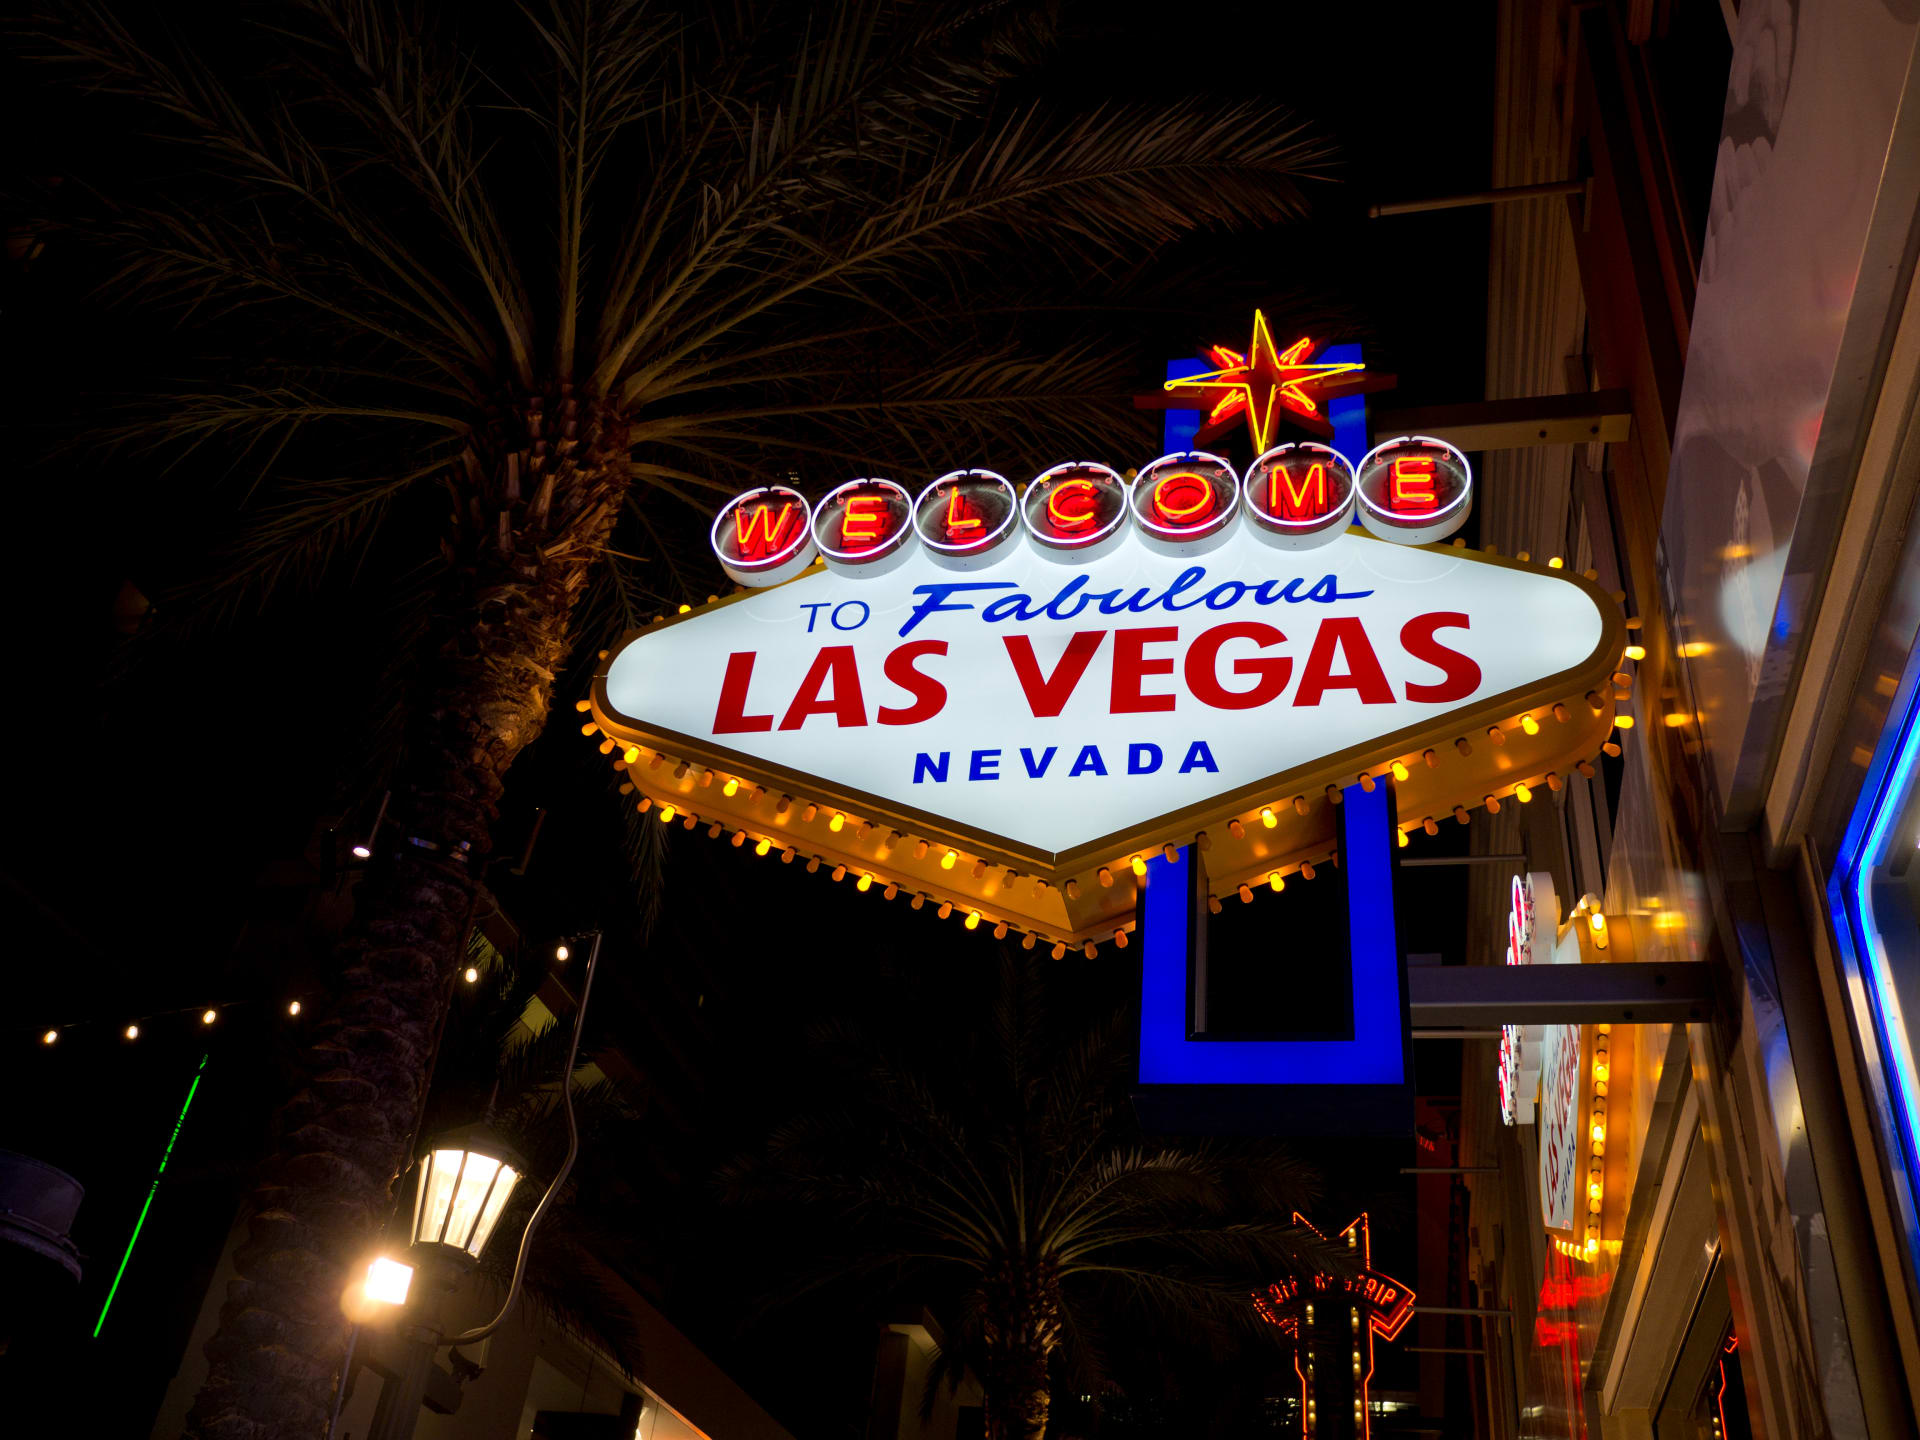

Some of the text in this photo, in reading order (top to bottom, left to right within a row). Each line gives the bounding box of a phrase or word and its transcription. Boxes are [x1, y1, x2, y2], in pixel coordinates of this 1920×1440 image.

[735, 456, 1437, 556] WELCOME
[800, 566, 1374, 637] TO Fabulous
[711, 611, 1482, 735] LAS VEGAS
[912, 740, 1219, 784] NEVADA
